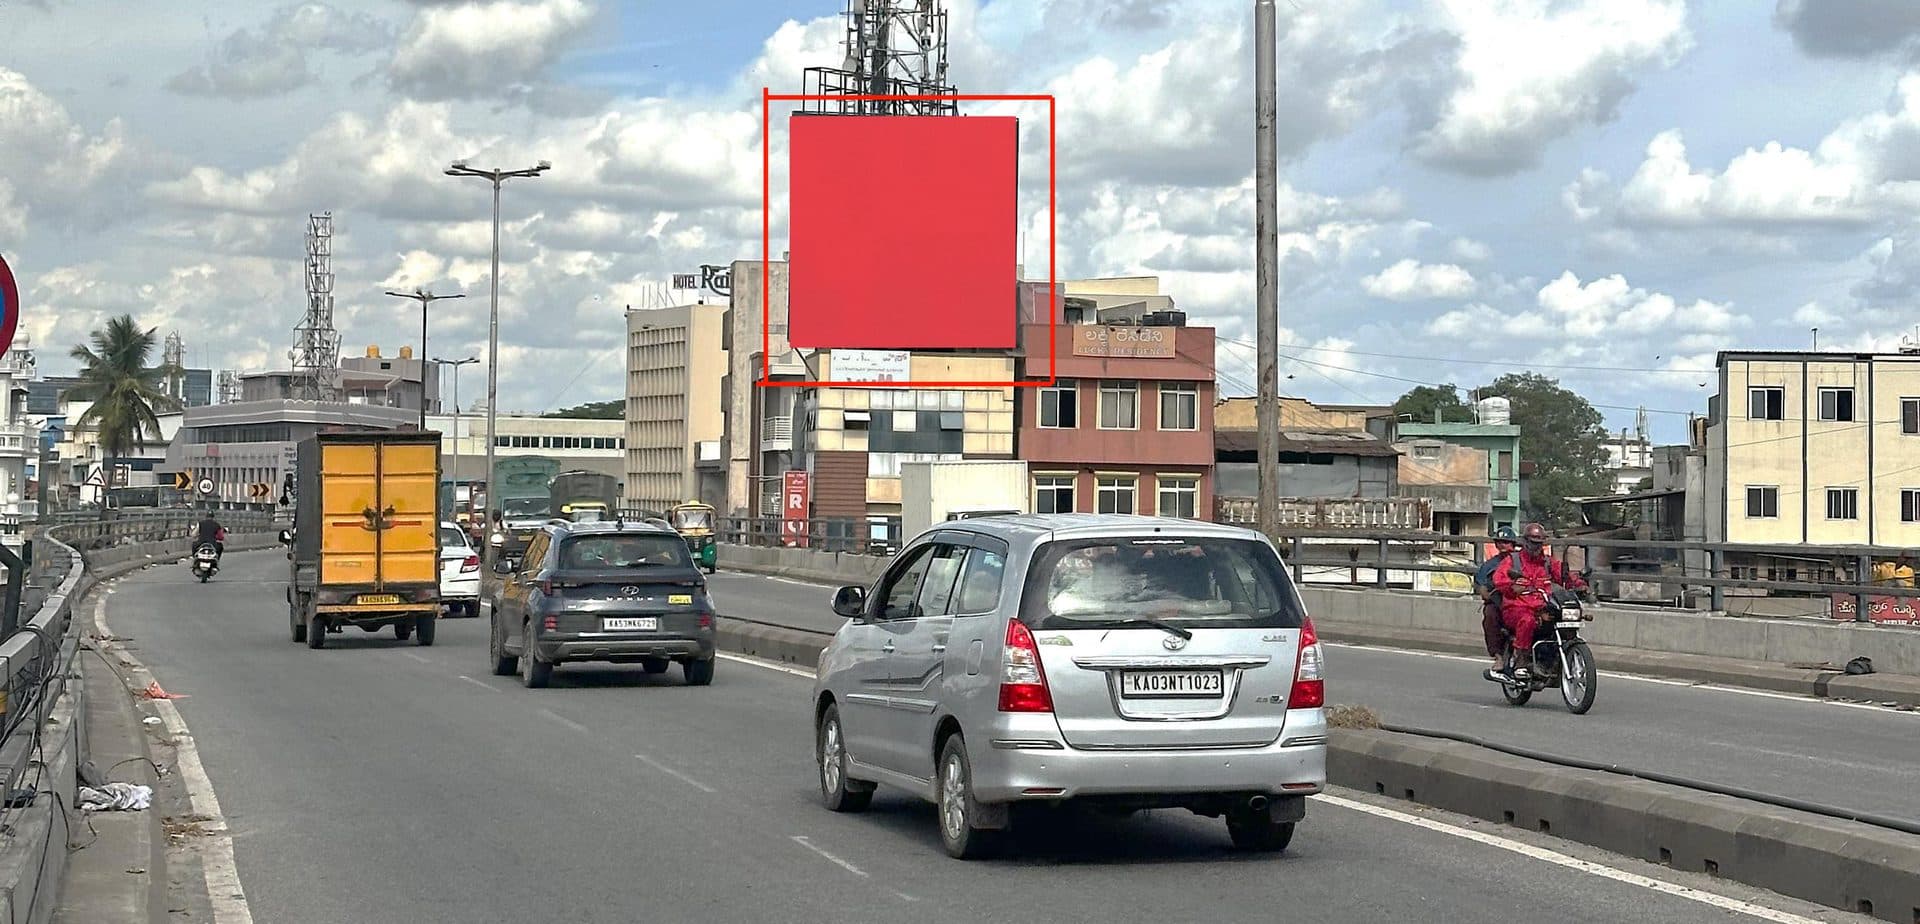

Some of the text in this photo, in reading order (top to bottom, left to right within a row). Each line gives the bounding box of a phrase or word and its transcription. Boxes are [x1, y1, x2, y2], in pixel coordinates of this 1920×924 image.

[673, 274, 698, 289] HOTEL
[201, 482, 211, 491] 40
[1133, 674, 1220, 691] KA03NT1023
